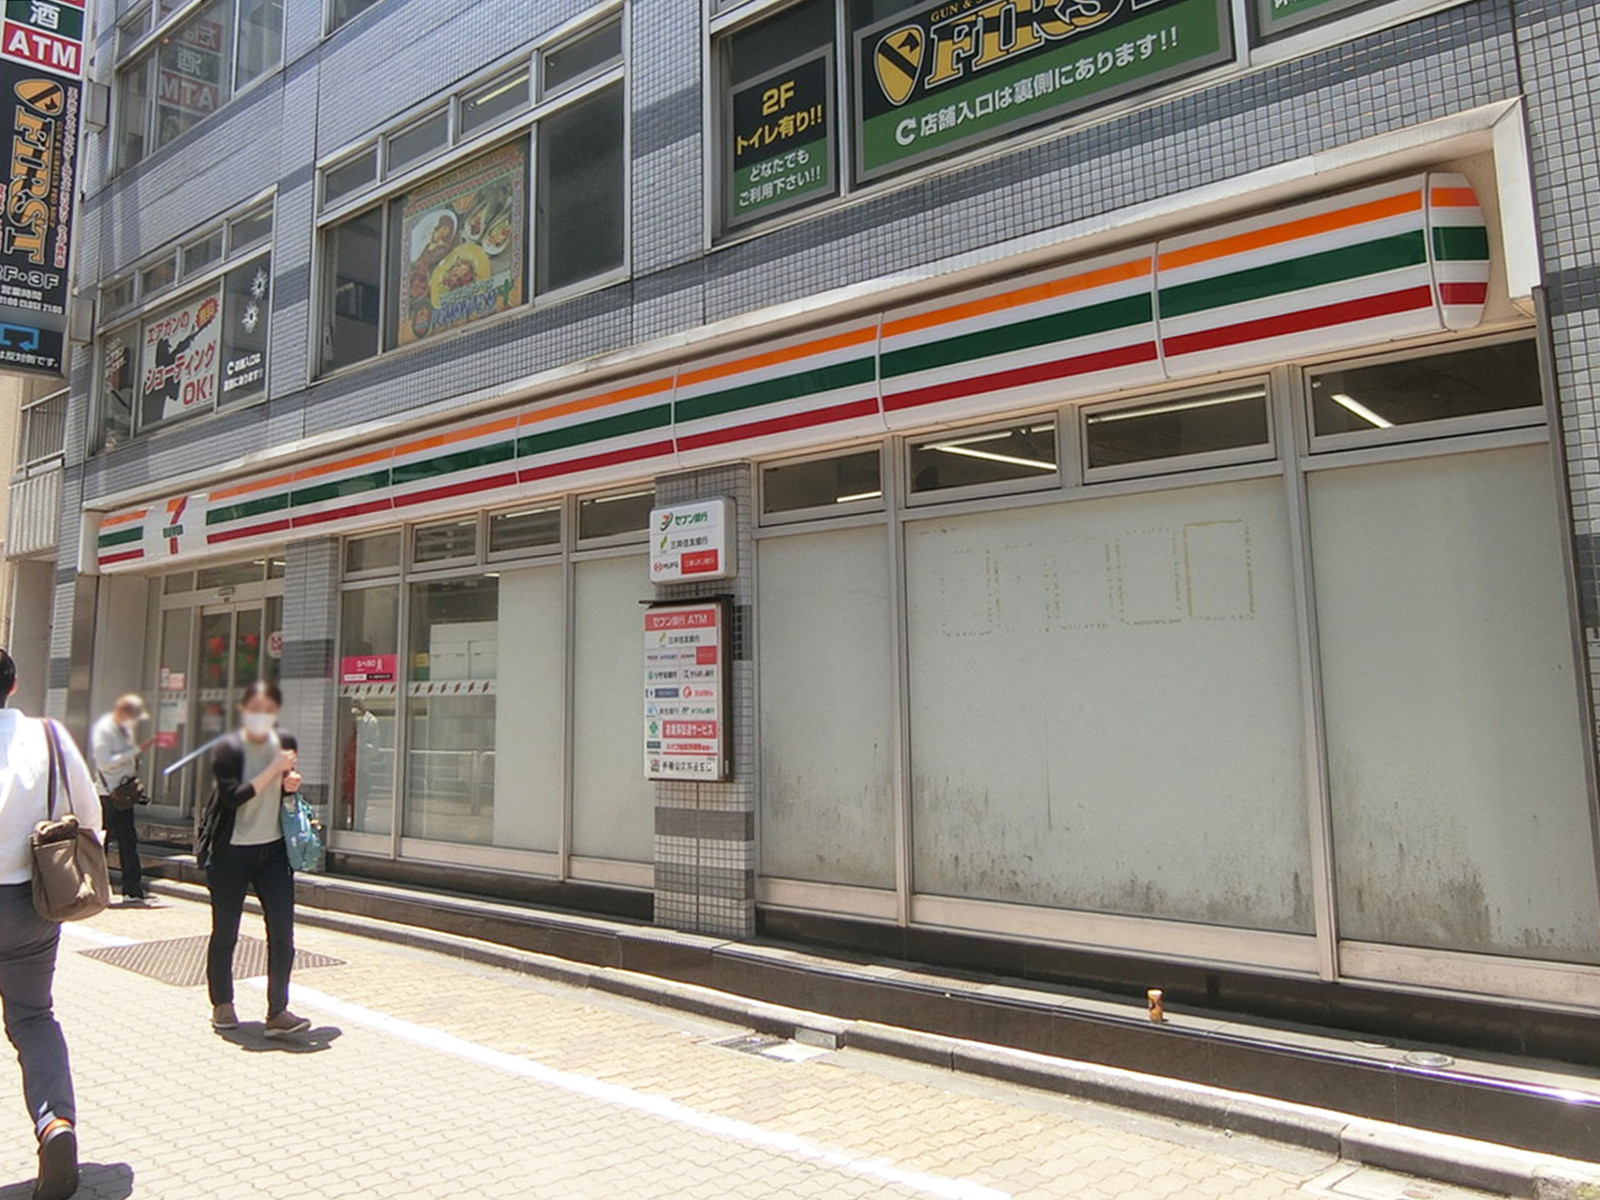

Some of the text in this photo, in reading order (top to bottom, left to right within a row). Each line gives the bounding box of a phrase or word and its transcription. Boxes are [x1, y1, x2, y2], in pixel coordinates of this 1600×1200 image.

[930, 3, 958, 22] GUN
[8, 29, 77, 70] ATM
[925, 0, 1164, 89] FIRS
[763, 81, 795, 116] 2F
[737, 104, 822, 156] トイレ有り!!
[750, 149, 809, 182] どなたでも
[4, 104, 55, 265] FIRST
[739, 166, 820, 206] ご利用下さい!!
[147, 311, 190, 345] エアガンの
[183, 374, 214, 405] OK!
[675, 511, 708, 526] セブン銀行
[670, 536, 709, 550] 三井住友銀行
[653, 614, 708, 627] セブン銀行 ATM
[668, 635, 700, 645] 三井住友銀行
